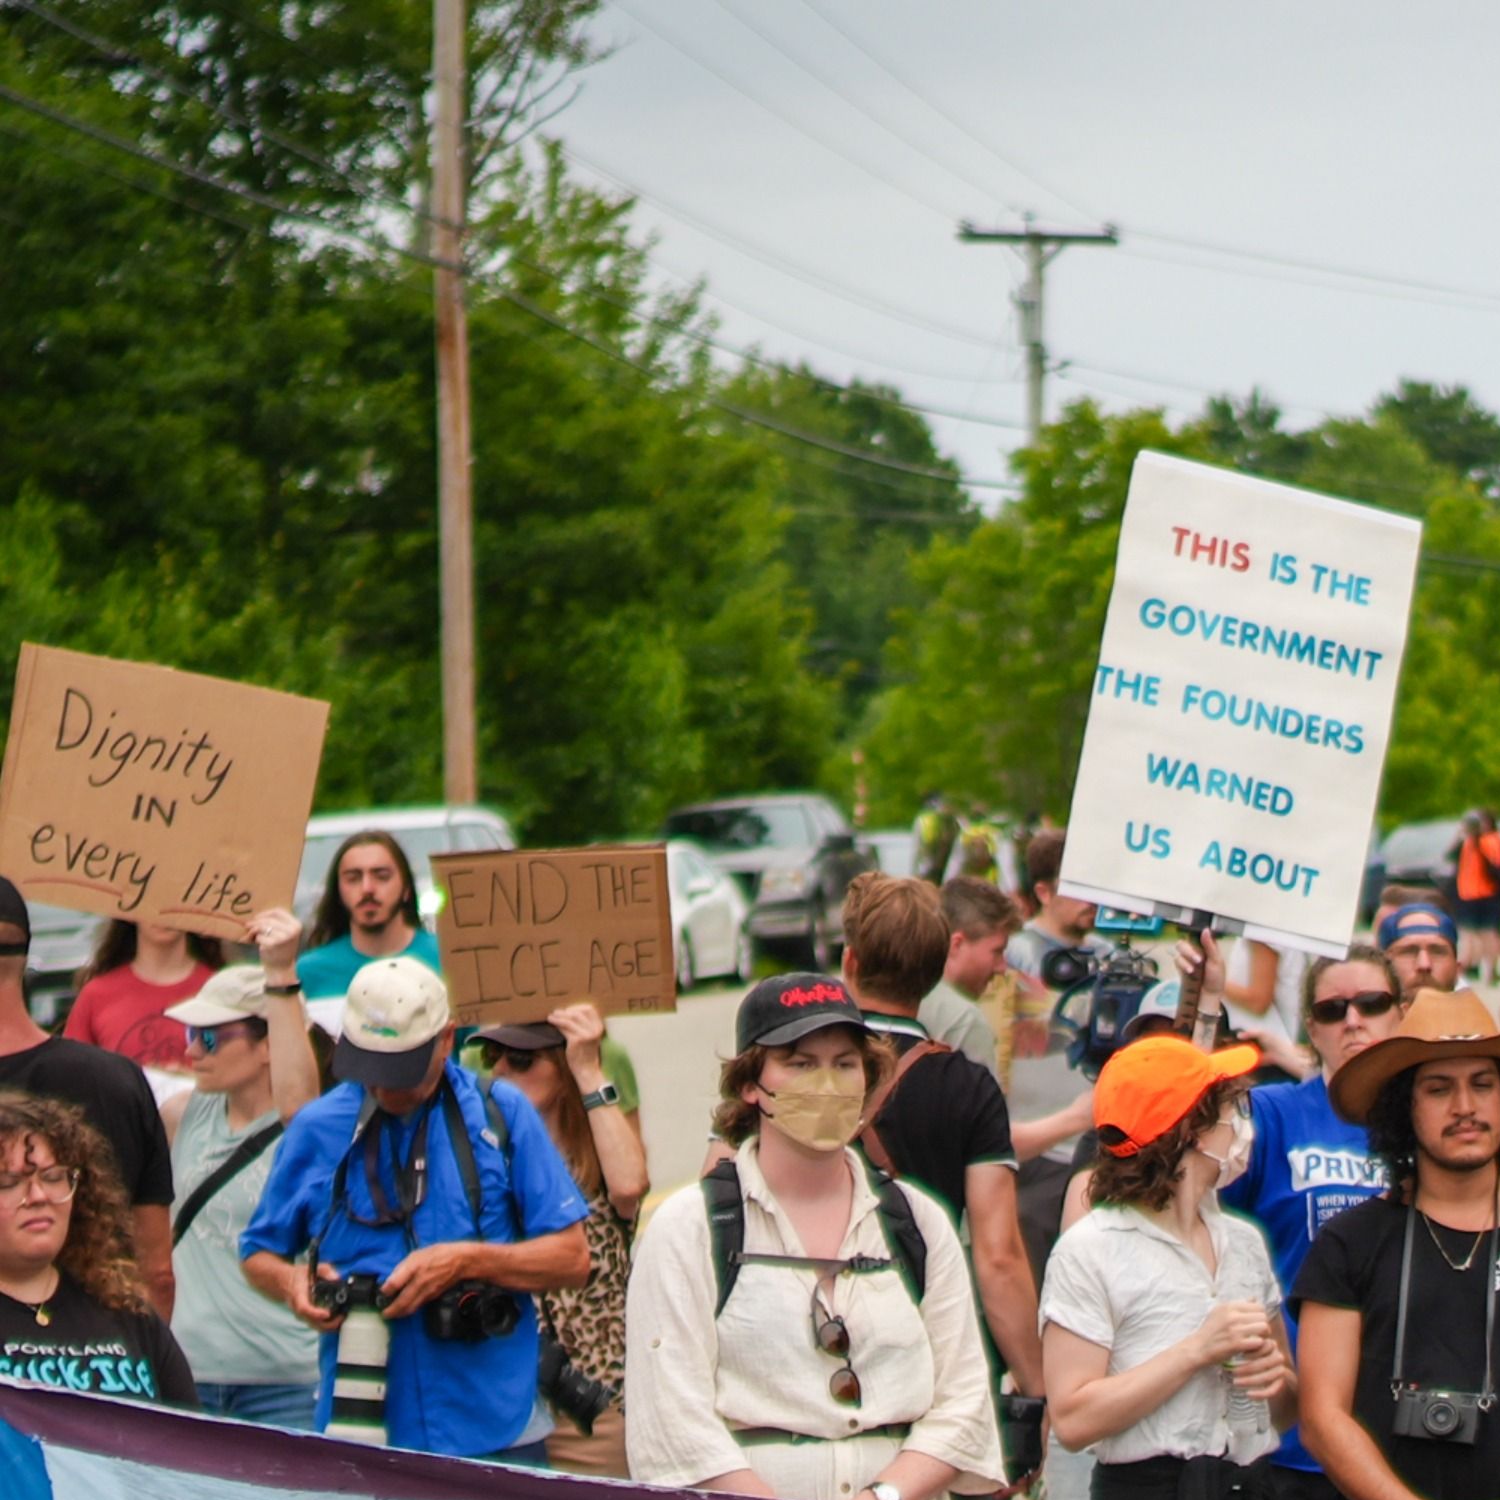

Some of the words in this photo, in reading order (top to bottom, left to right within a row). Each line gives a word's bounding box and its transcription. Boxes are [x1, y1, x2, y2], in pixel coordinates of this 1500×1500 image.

[1171, 525, 1251, 573] THIS
[1269, 552, 1298, 585] IS
[1310, 563, 1372, 606] THE
[1138, 597, 1383, 682] GOVERNMENT
[55, 687, 234, 806] Dignity
[1096, 664, 1161, 706] THE
[1181, 684, 1365, 756] FOUNDERS
[132, 793, 177, 828] IN
[1146, 752, 1294, 817] WARNED
[30, 824, 156, 913] every
[181, 861, 253, 915] life
[448, 860, 569, 929] END
[580, 863, 653, 912] THE
[1124, 820, 1172, 859] US
[1199, 840, 1320, 898] ABOUT
[450, 940, 569, 1008] ICE
[588, 938, 660, 994] AGE
[4, 1342, 128, 1357] PORTLAND
